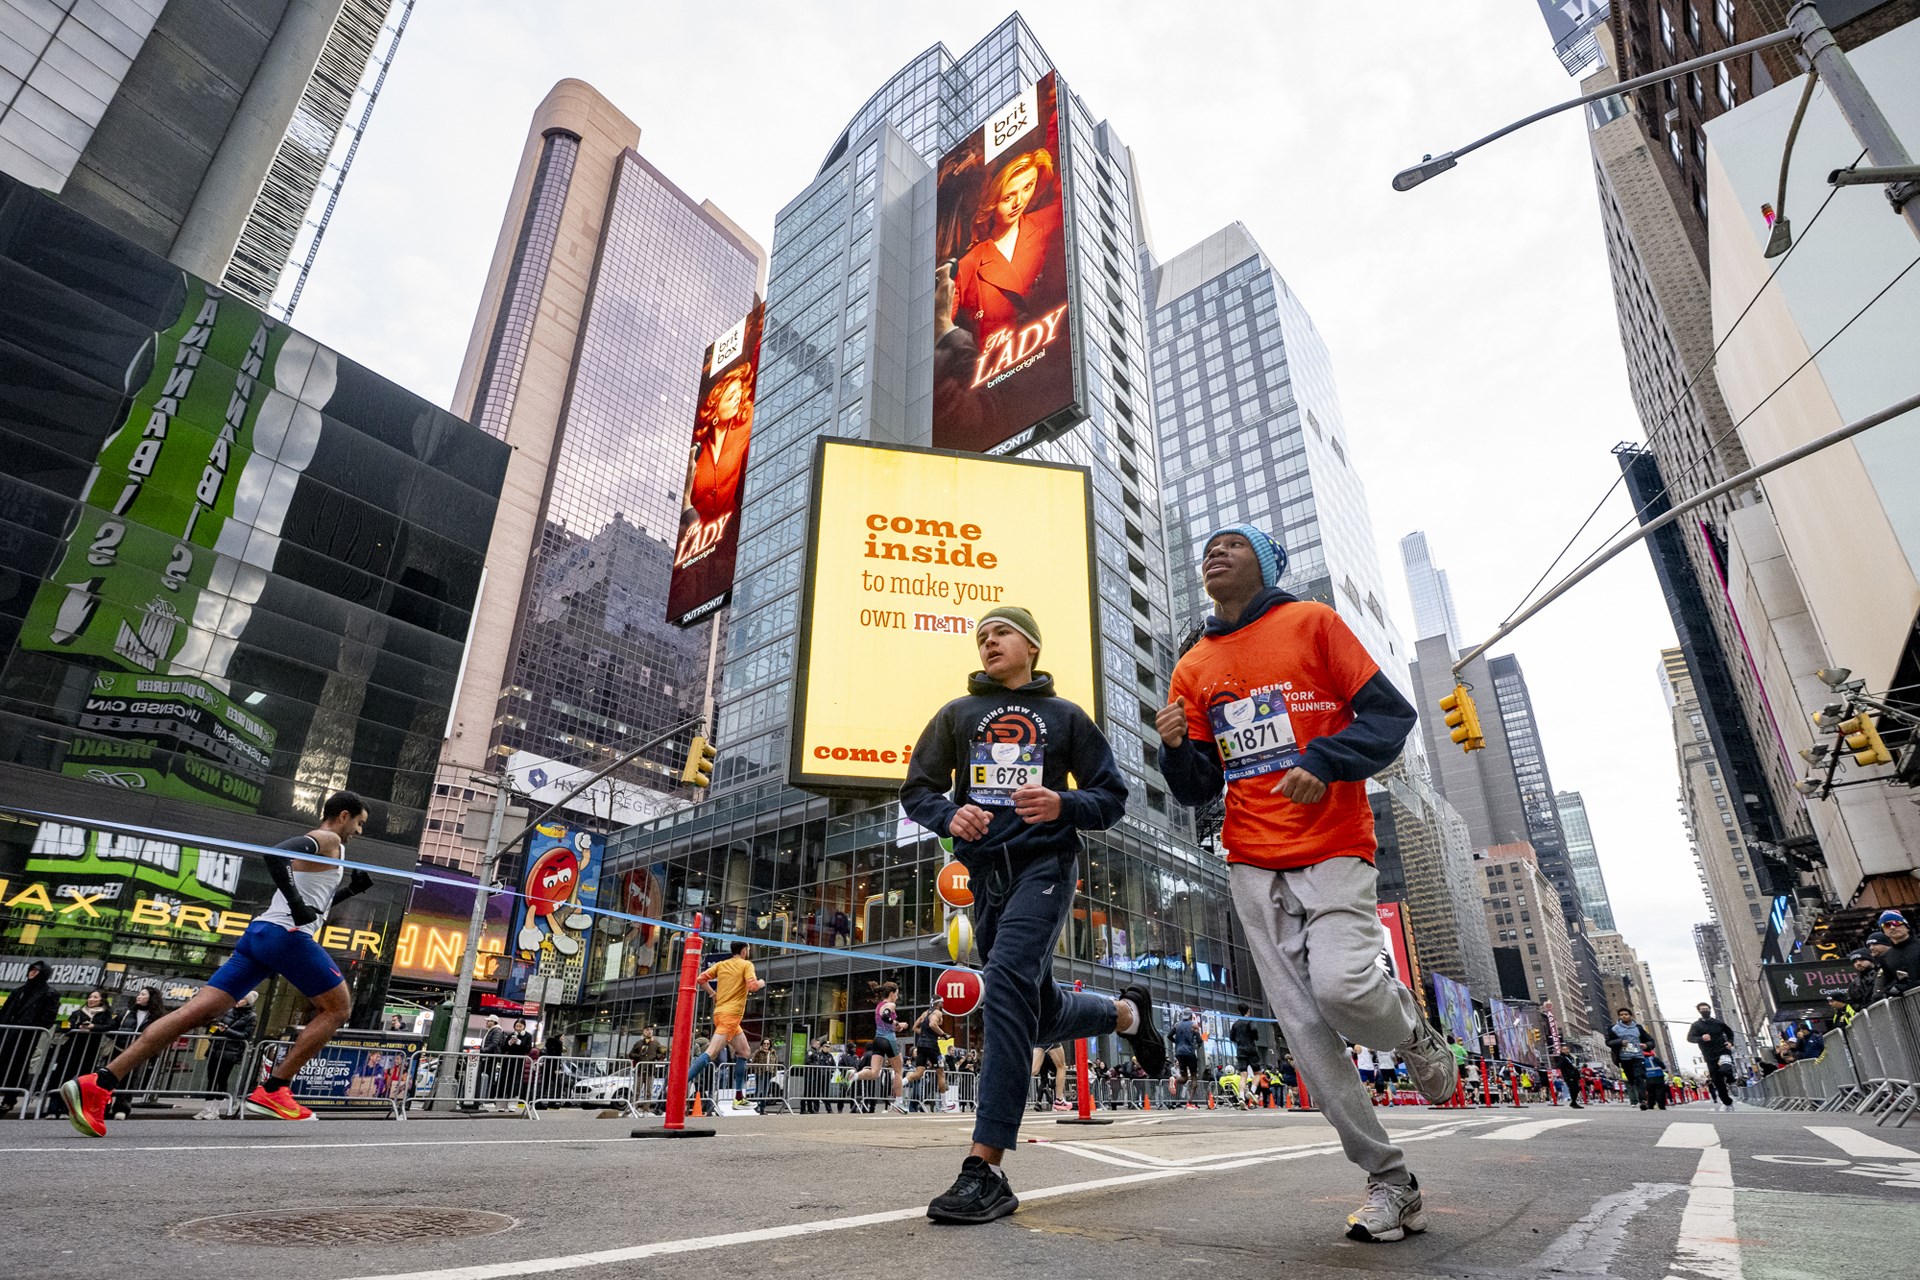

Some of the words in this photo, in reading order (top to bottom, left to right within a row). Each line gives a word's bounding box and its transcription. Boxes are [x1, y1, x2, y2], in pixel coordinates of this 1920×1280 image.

[994, 102, 1026, 133] brit
[994, 116, 1027, 146] box
[719, 330, 738, 352] brit
[970, 305, 1067, 389] LADY
[984, 327, 1015, 353] The
[717, 343, 738, 364] box
[987, 368, 1016, 388] britbox
[1016, 349, 1046, 372] original
[674, 512, 732, 567] LADY
[866, 514, 982, 541] come
[864, 533, 998, 569] inside
[862, 570, 885, 592] to
[890, 573, 949, 598] make
[953, 582, 1004, 606] your
[860, 609, 906, 629] own
[1250, 681, 1293, 696] RISING
[1284, 691, 1315, 701] YORK
[1291, 701, 1337, 712] RUNNERS
[977, 707, 1004, 733] RISING
[1007, 705, 1030, 714] NEW
[1031, 712, 1048, 735] YORK
[1220, 738, 1231, 758] E
[1233, 721, 1279, 752] 1871
[814, 745, 897, 765] come
[975, 766, 985, 783] E
[996, 767, 1028, 785] 678
[0, 879, 106, 918] AX
[131, 899, 382, 954] BREER
[947, 983, 965, 999] m
[299, 1066, 350, 1078] strangers
